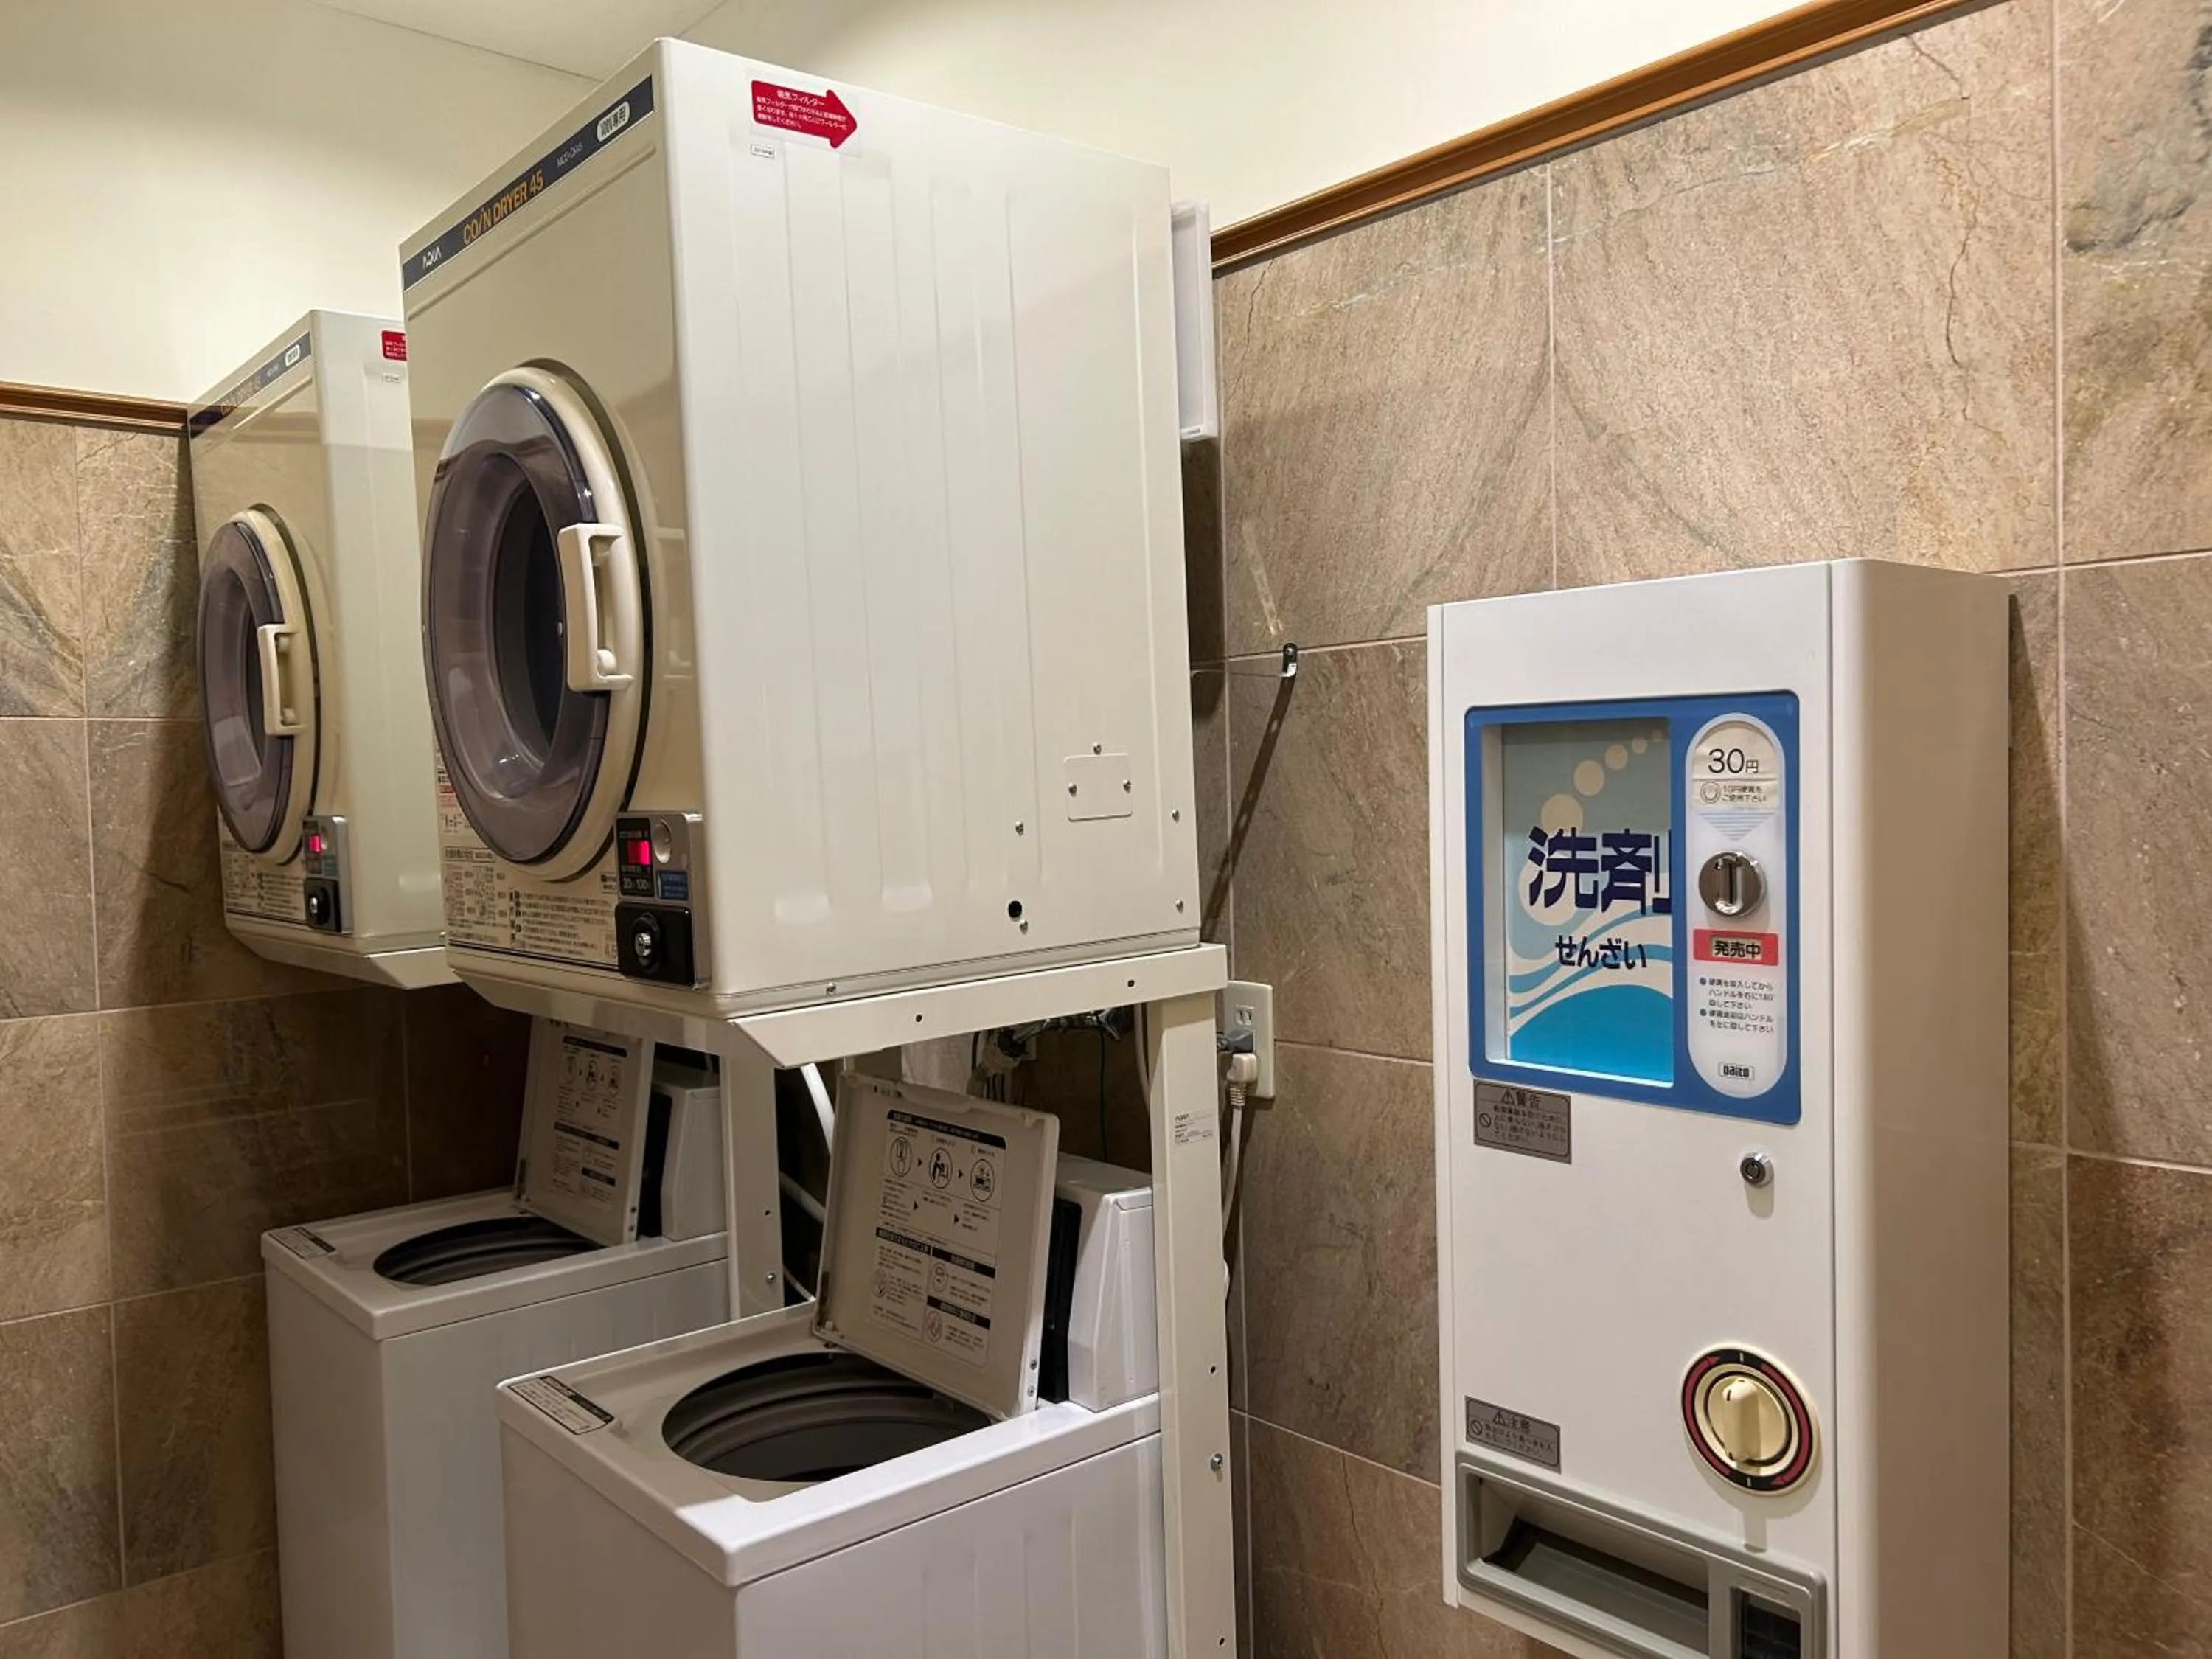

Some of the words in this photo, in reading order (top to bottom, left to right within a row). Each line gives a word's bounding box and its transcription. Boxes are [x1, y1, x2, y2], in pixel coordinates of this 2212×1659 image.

[493, 181, 527, 223] DRYER
[530, 169, 543, 195] 45
[1708, 748, 1759, 773] 30円
[1528, 825, 1672, 915] 洗剤
[1555, 935, 1646, 970] せんざい
[1714, 940, 1761, 958] 発売中
